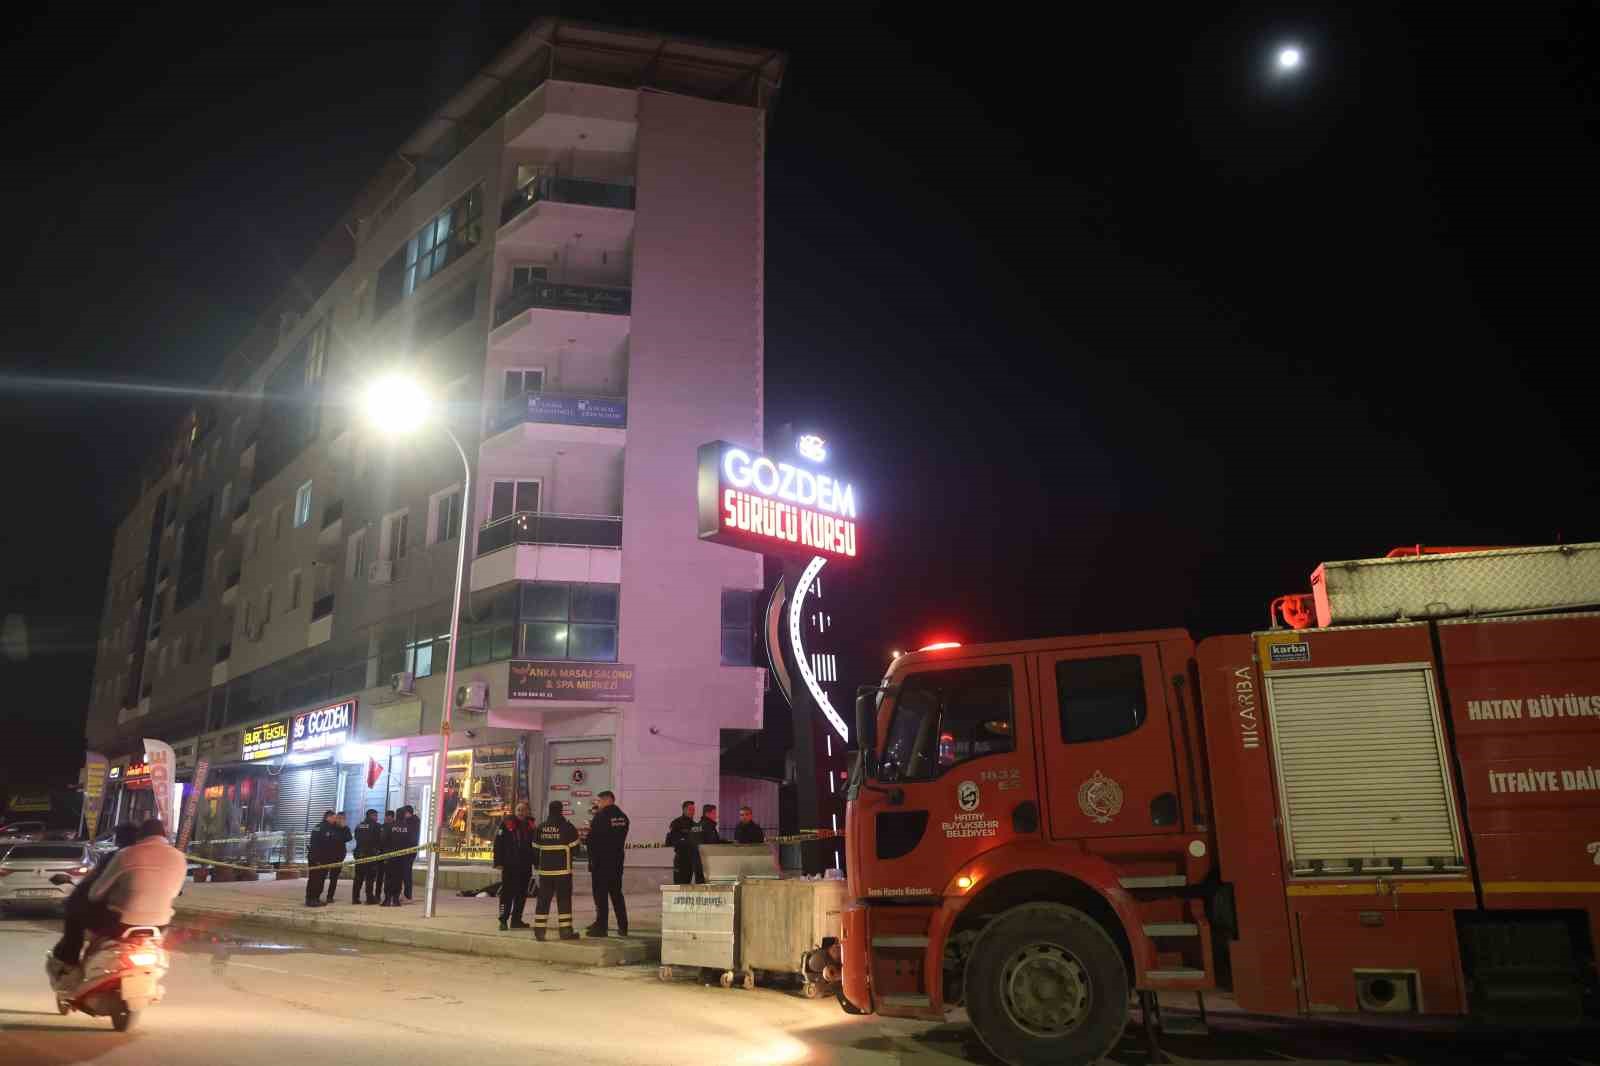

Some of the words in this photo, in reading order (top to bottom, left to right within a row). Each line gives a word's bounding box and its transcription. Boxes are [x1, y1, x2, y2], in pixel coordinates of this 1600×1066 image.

[724, 489, 798, 542] SÜRÜCÜ
[801, 509, 857, 557] KURSU
[528, 667, 558, 677] ANKA
[556, 679, 575, 689] SPA
[1467, 699, 1523, 720] HATAY
[1488, 769, 1560, 793] İTFAİYE
[954, 813, 985, 821] HATAY
